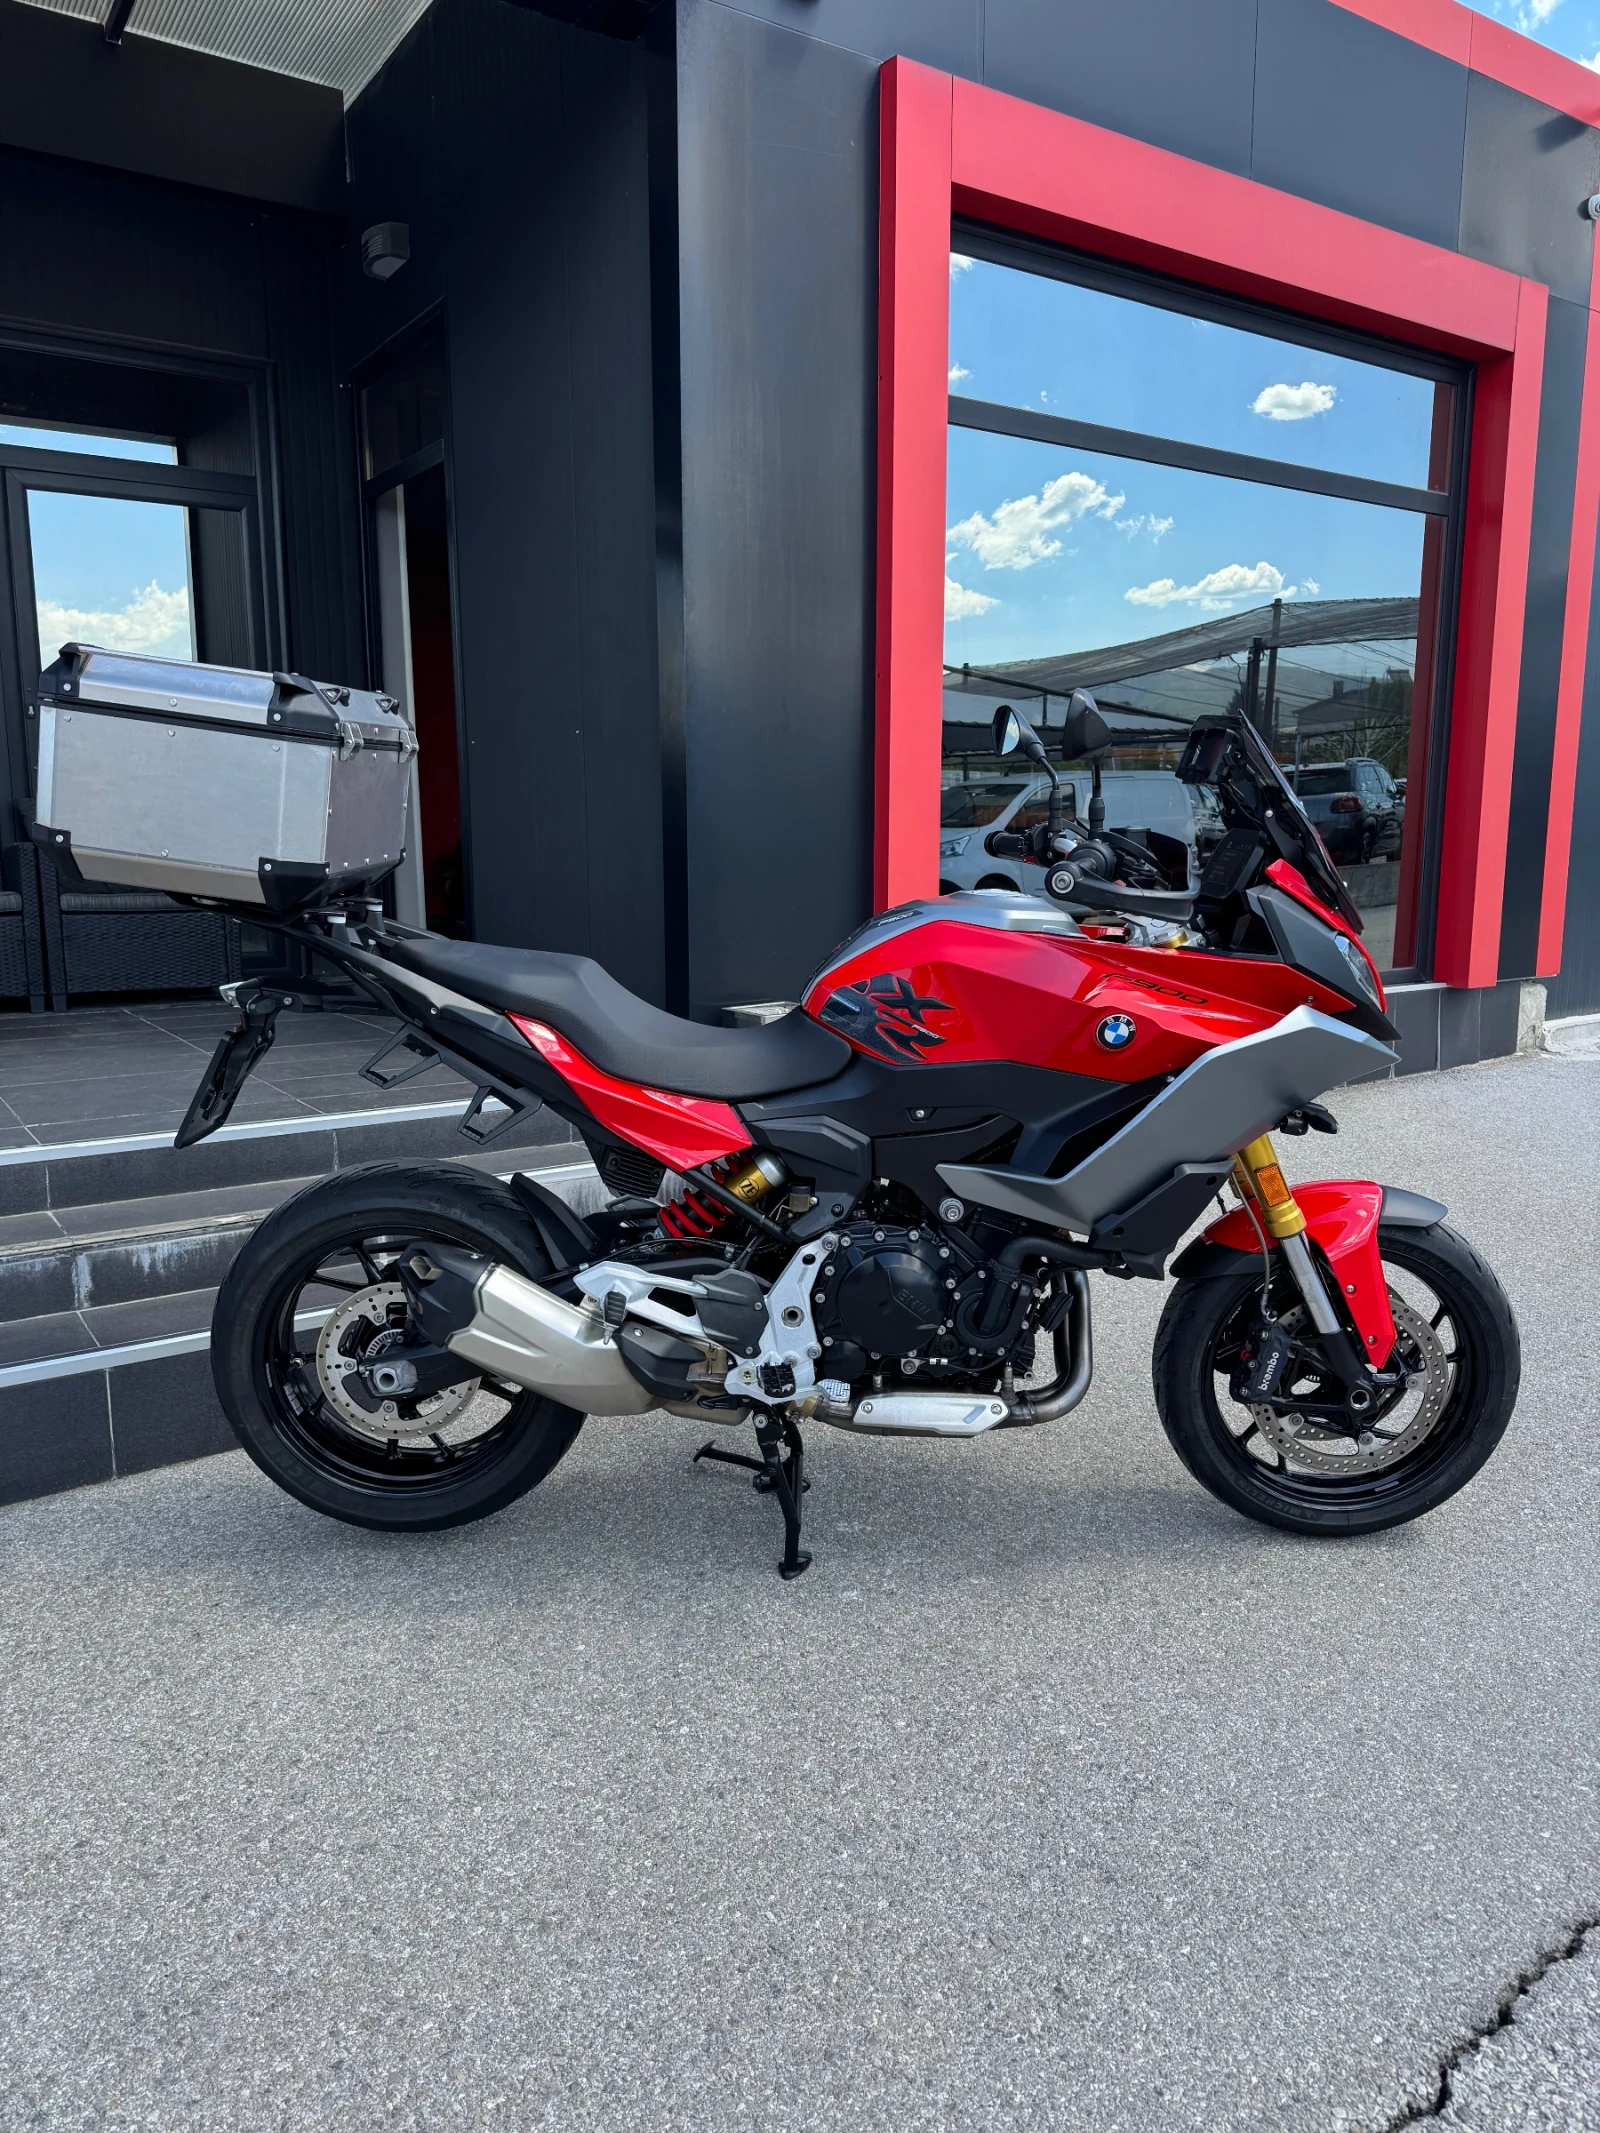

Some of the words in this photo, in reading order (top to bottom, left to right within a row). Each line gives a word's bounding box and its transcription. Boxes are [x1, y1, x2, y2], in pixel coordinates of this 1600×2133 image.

[1106, 1016, 1136, 1032] BMW
[897, 1288, 931, 1316] BMW
[1258, 1351, 1280, 1391] brembo
[1237, 1480, 1302, 1516] MICHELIN
